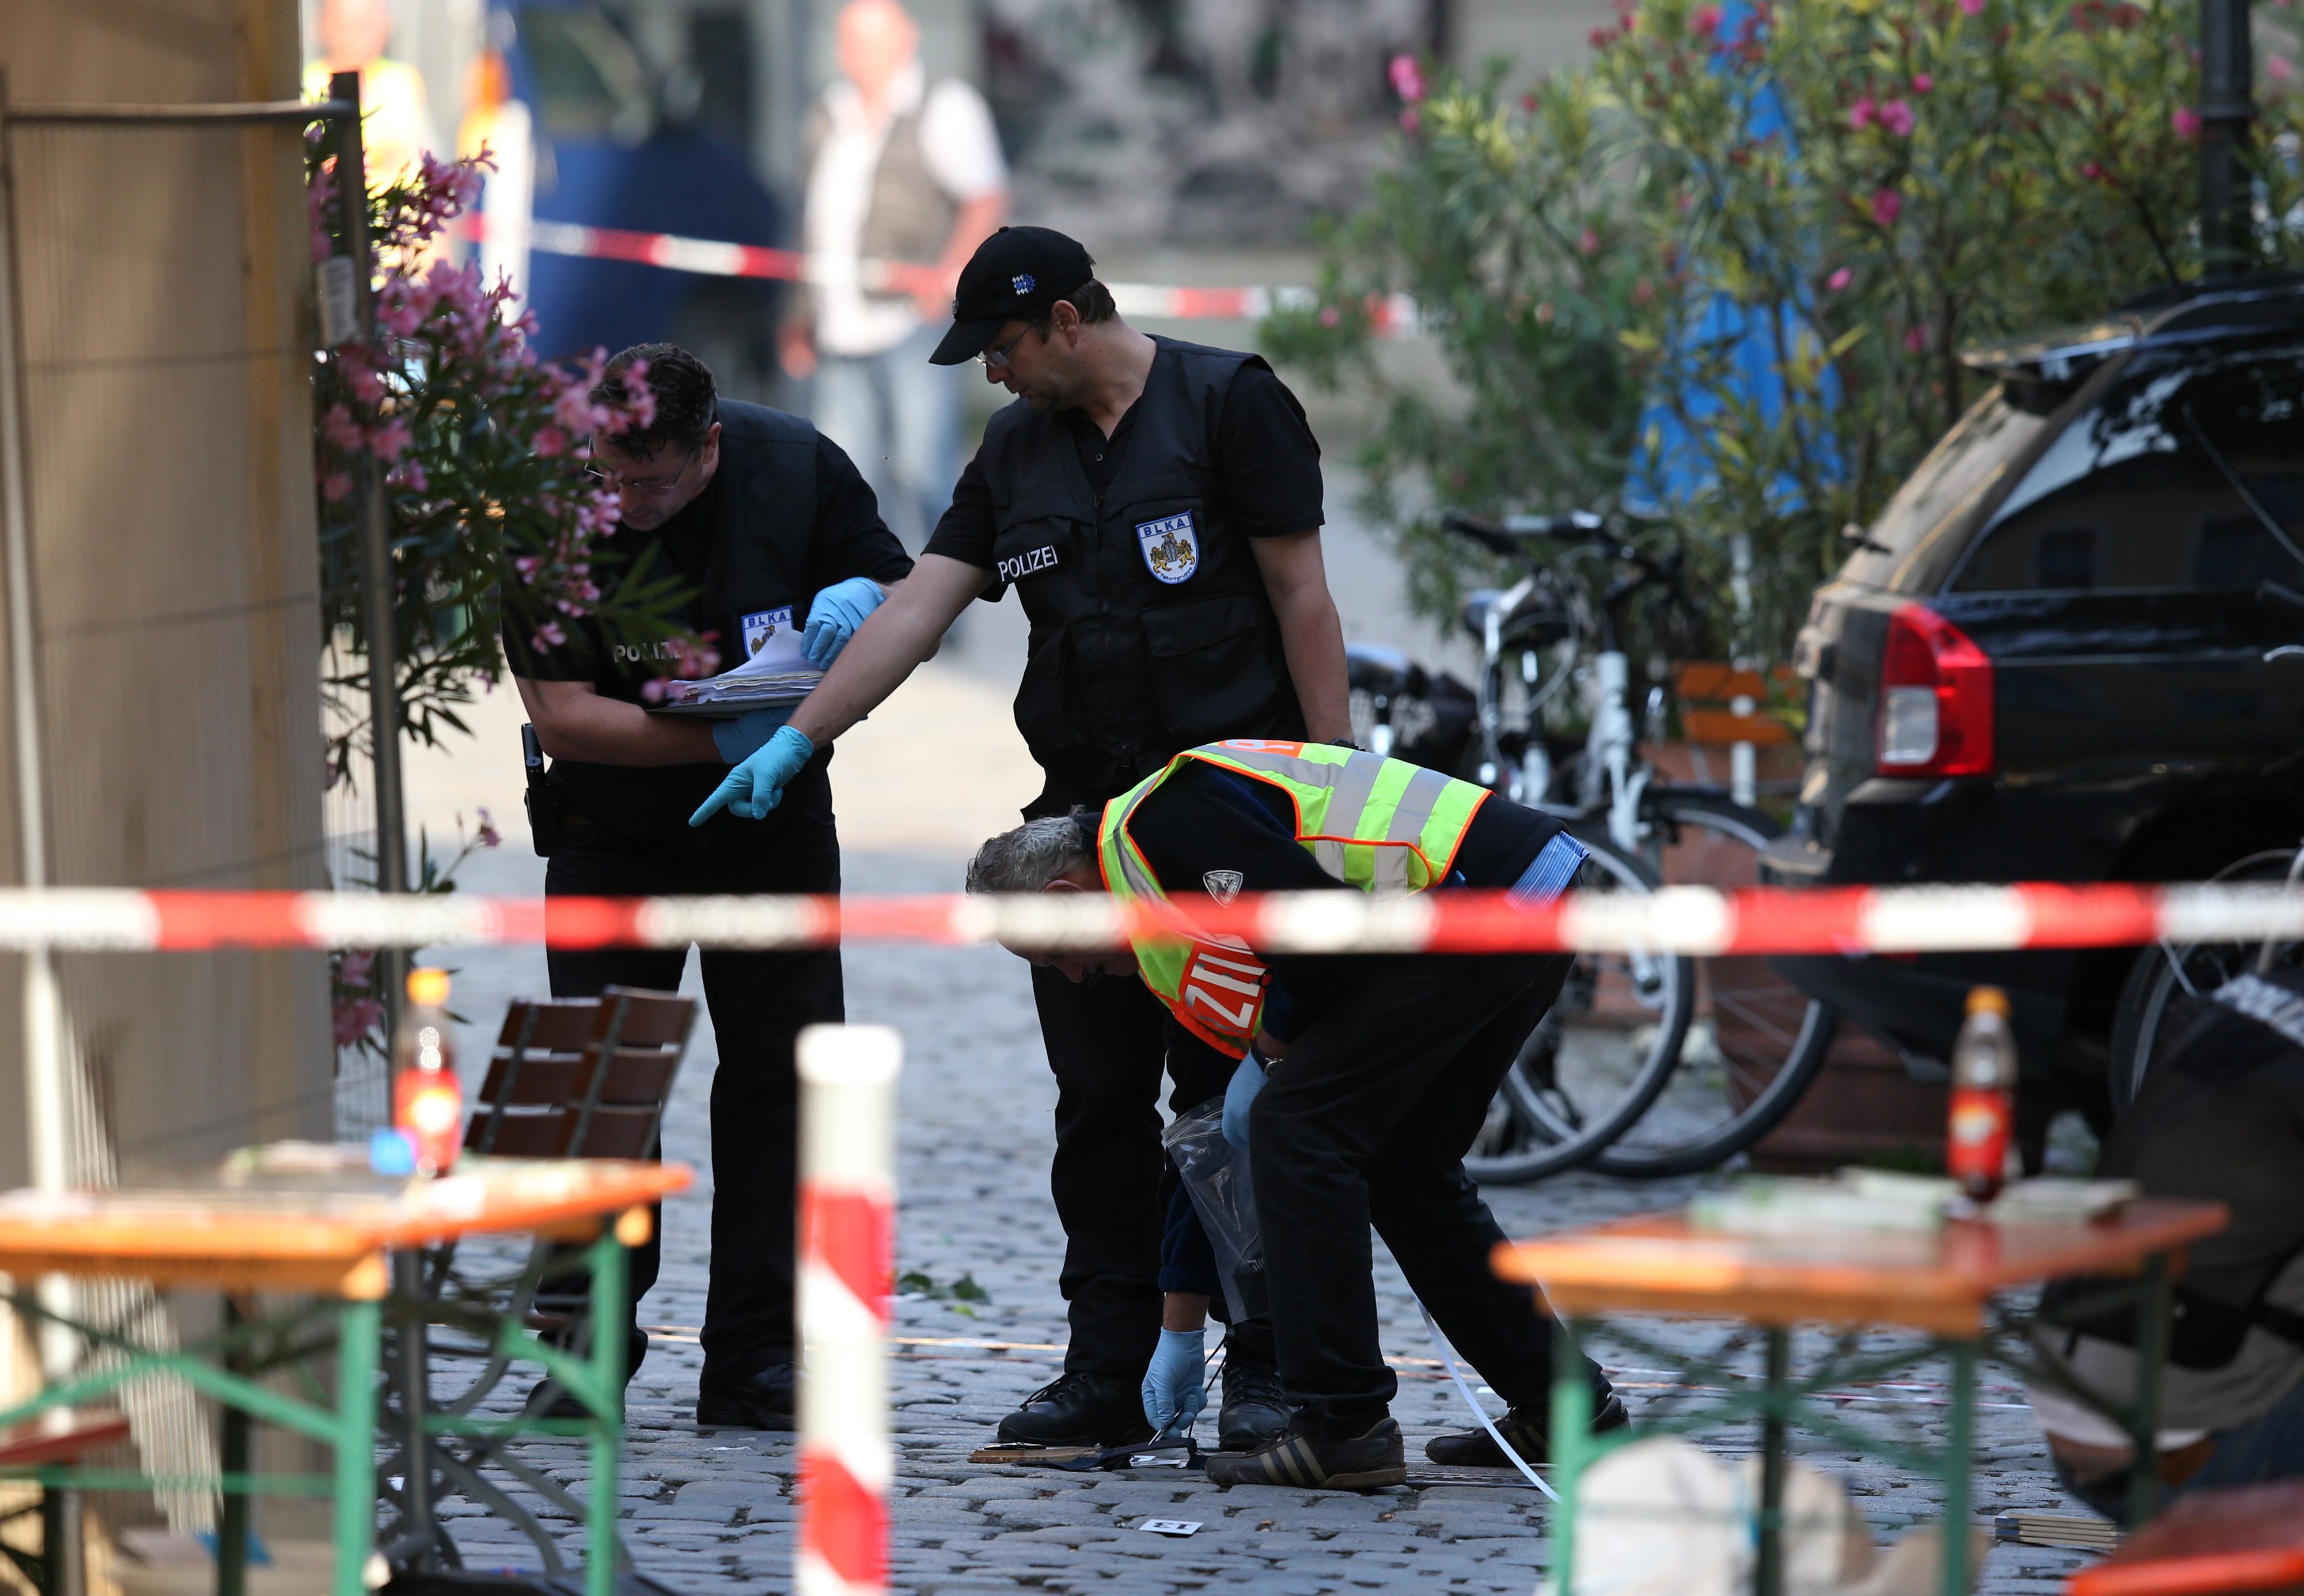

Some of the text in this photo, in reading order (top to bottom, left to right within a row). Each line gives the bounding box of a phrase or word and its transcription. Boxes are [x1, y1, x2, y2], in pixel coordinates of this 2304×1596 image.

[1143, 518, 1185, 536] BLKA
[998, 545, 1058, 581] POLIZEI
[749, 612, 787, 627] BLKA
